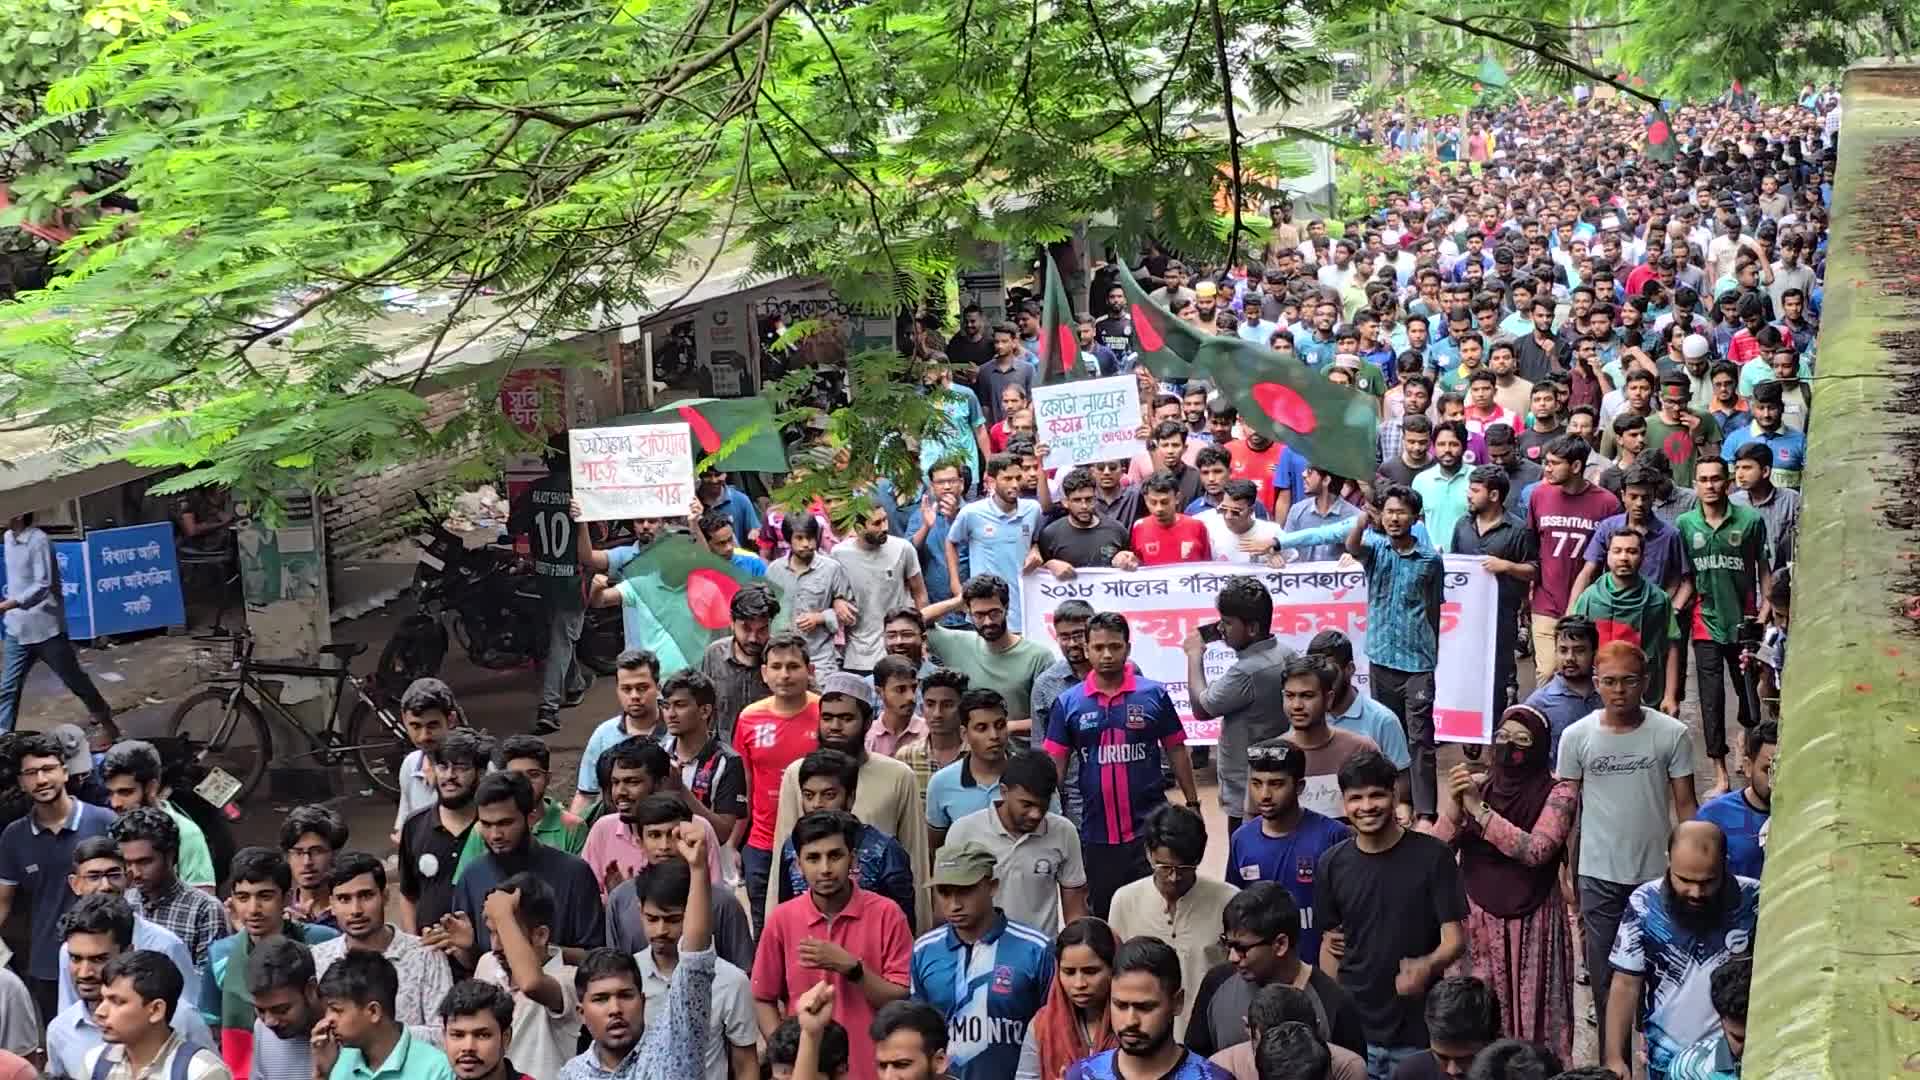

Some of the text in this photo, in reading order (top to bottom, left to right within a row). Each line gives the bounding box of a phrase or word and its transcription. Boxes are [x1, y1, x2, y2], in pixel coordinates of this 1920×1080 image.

[535, 511, 570, 558] 10
[1551, 530, 1586, 558] 77
[1040, 583, 1094, 599] ২০১৮
[1102, 579, 1168, 598] সালের
